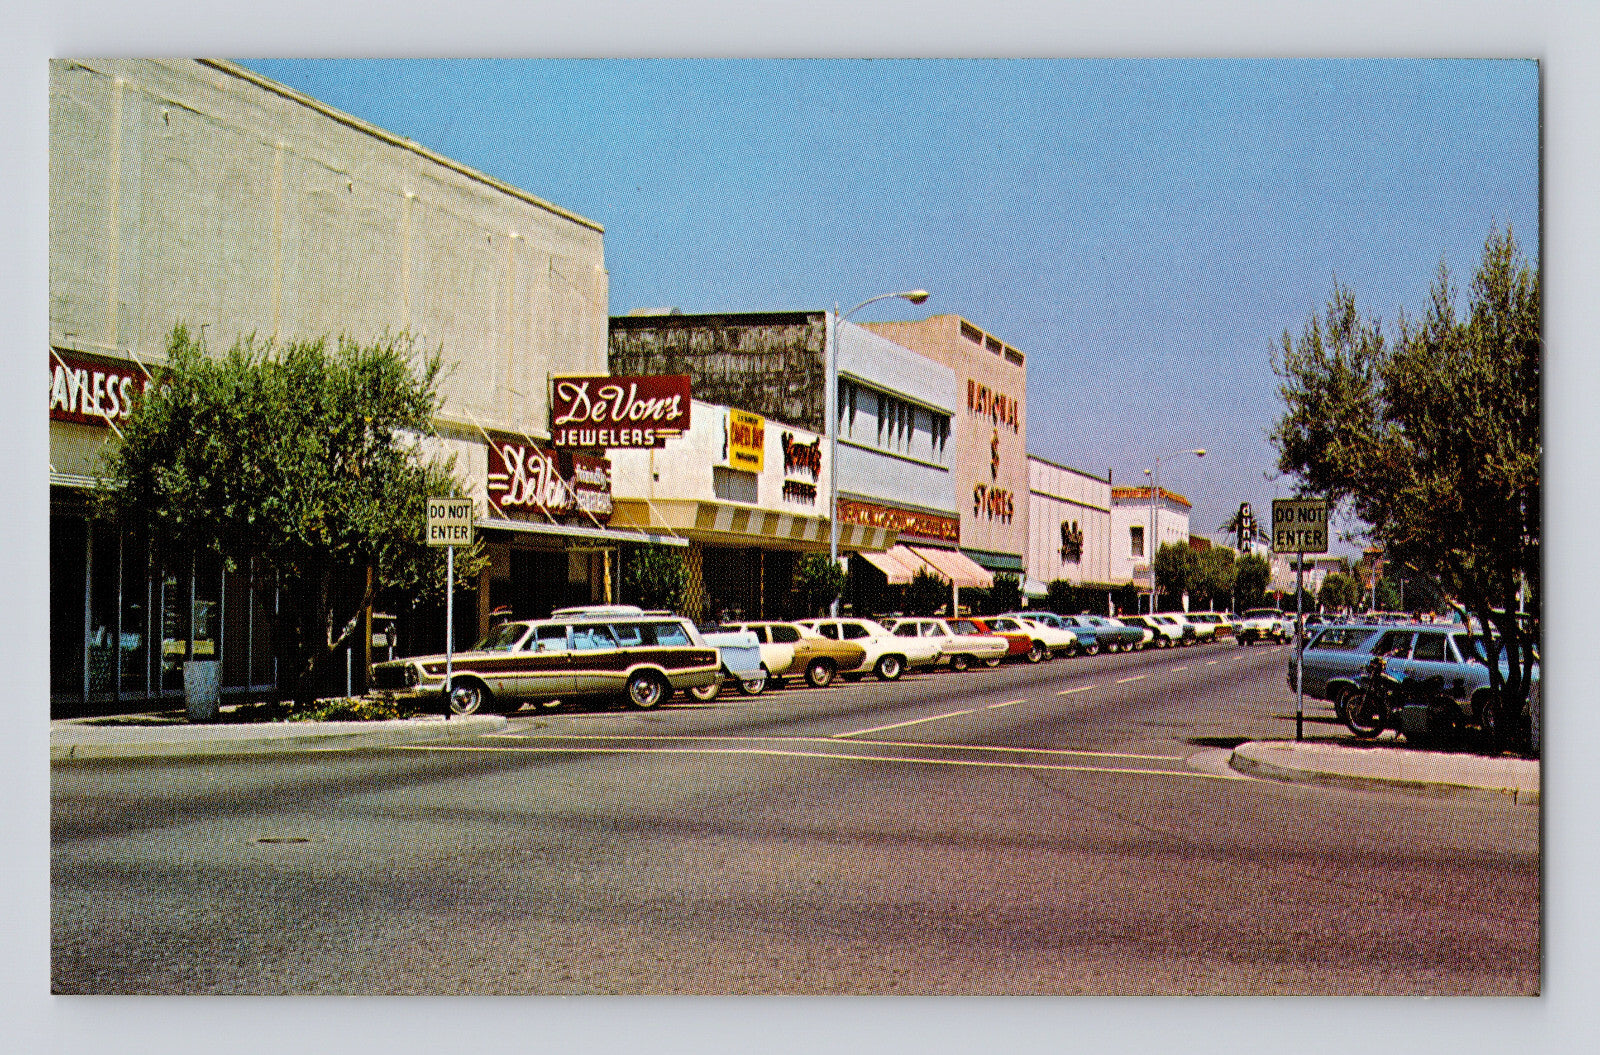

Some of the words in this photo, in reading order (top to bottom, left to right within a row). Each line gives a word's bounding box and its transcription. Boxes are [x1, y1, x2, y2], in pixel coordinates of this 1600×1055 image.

[967, 378, 1020, 431] NATIONAL
[555, 429, 655, 446] JEWELERS
[973, 482, 1014, 521] STORES
[430, 504, 446, 518] DO
[448, 504, 470, 518] NOT
[1275, 507, 1294, 523] DO
[1298, 507, 1324, 523] NOT
[431, 525, 468, 539] ENTER
[1277, 530, 1323, 546] ENTER
